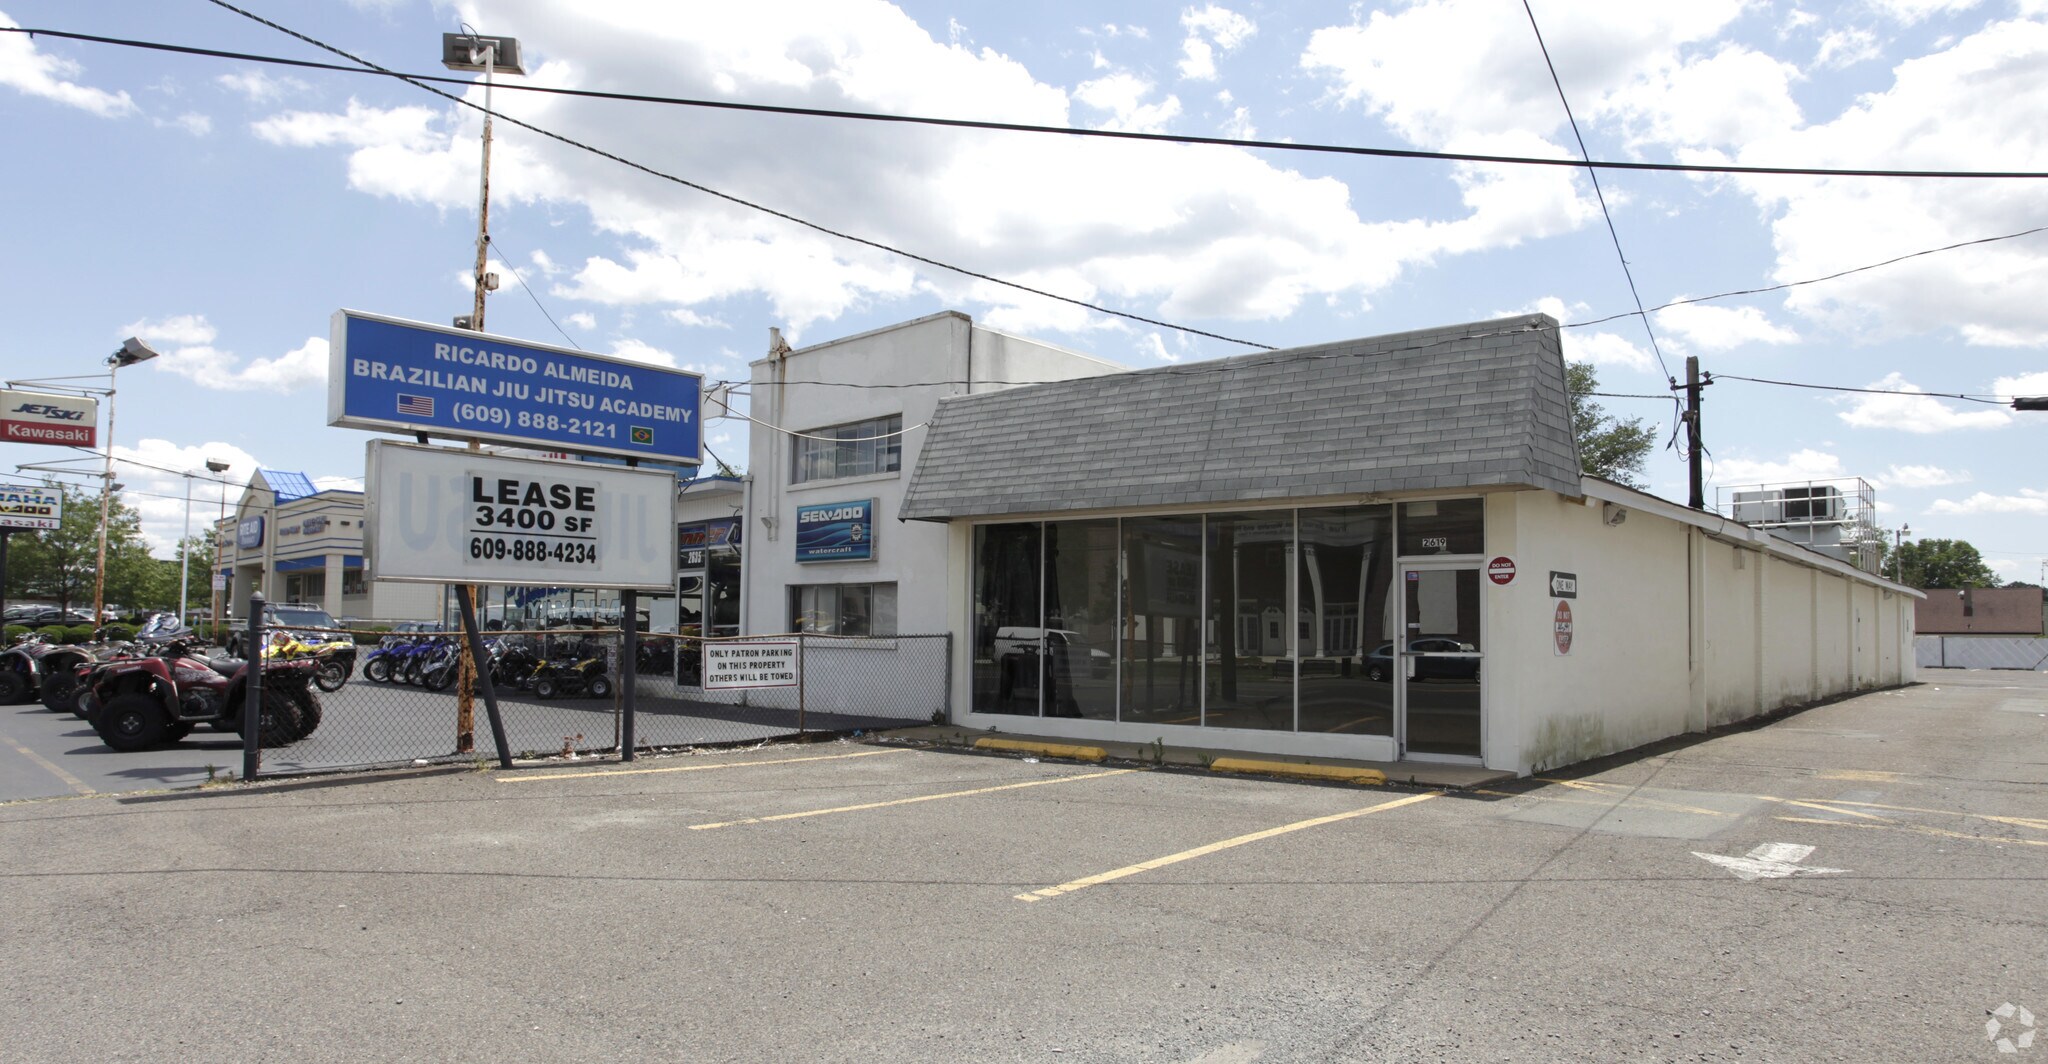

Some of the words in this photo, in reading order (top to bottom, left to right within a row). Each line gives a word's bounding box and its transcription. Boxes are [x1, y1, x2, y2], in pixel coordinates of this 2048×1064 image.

[435, 342, 538, 374] RICARDO
[544, 361, 633, 390] ALMEIDA
[353, 358, 486, 394] BRAZILIAN
[492, 380, 529, 400] JIU
[534, 387, 594, 409] JITSU
[600, 397, 692, 423] ACADEMY
[453, 402, 511, 429] (609)
[518, 411, 616, 438] 888-2121
[8, 424, 89, 441] Kawasaki
[473, 477, 595, 511] LEASE
[476, 505, 555, 530] 3400
[564, 516, 592, 532] SF
[470, 537, 596, 563] 609-888-4234
[809, 546, 852, 554] watercraft
[1423, 537, 1446, 547] 2619
[731, 649, 759, 657] PATRON
[718, 662, 727, 670] ON
[749, 661, 785, 669] PROPERTY
[710, 674, 737, 682] OTHERS
